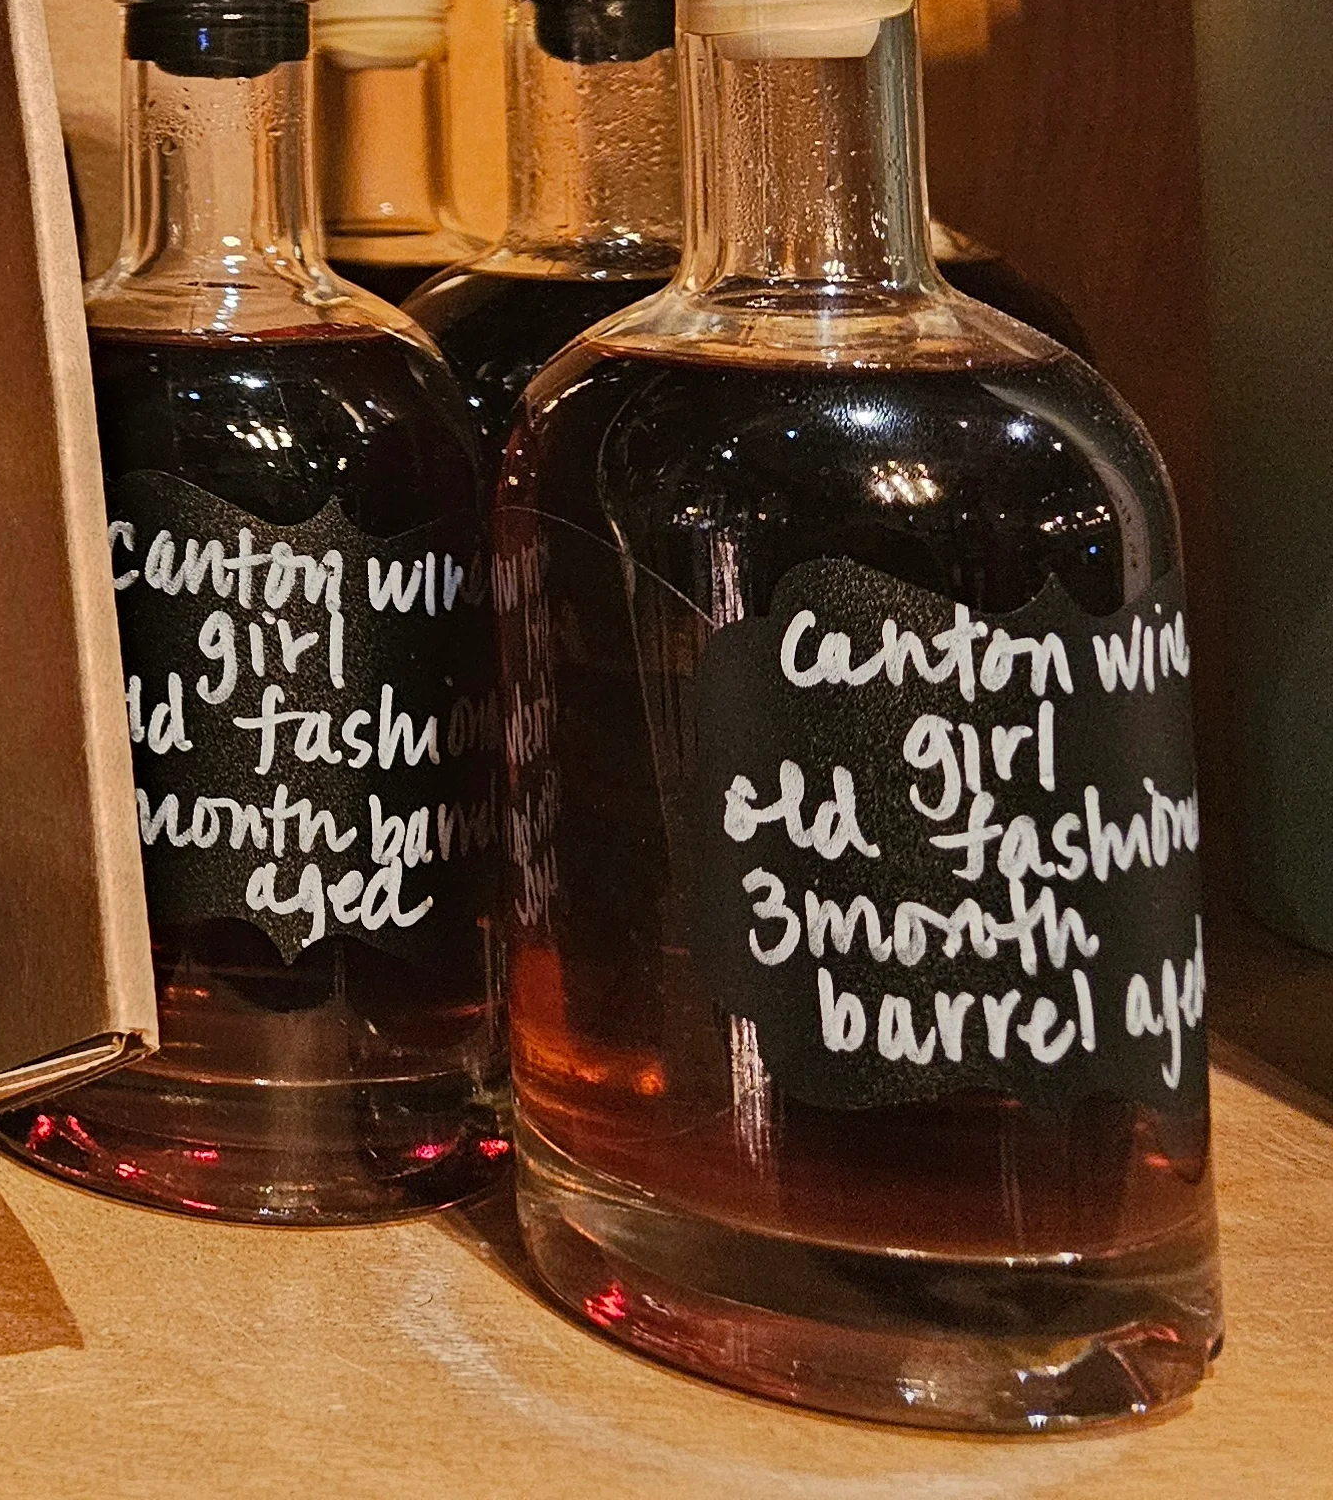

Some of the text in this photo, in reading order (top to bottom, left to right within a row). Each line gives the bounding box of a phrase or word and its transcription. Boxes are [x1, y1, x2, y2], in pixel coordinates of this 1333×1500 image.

[196, 611, 345, 706] girl
[723, 758, 881, 860] old
[903, 700, 1055, 821] girl
[245, 855, 434, 948] aged
[817, 967, 1097, 1066] barrel
